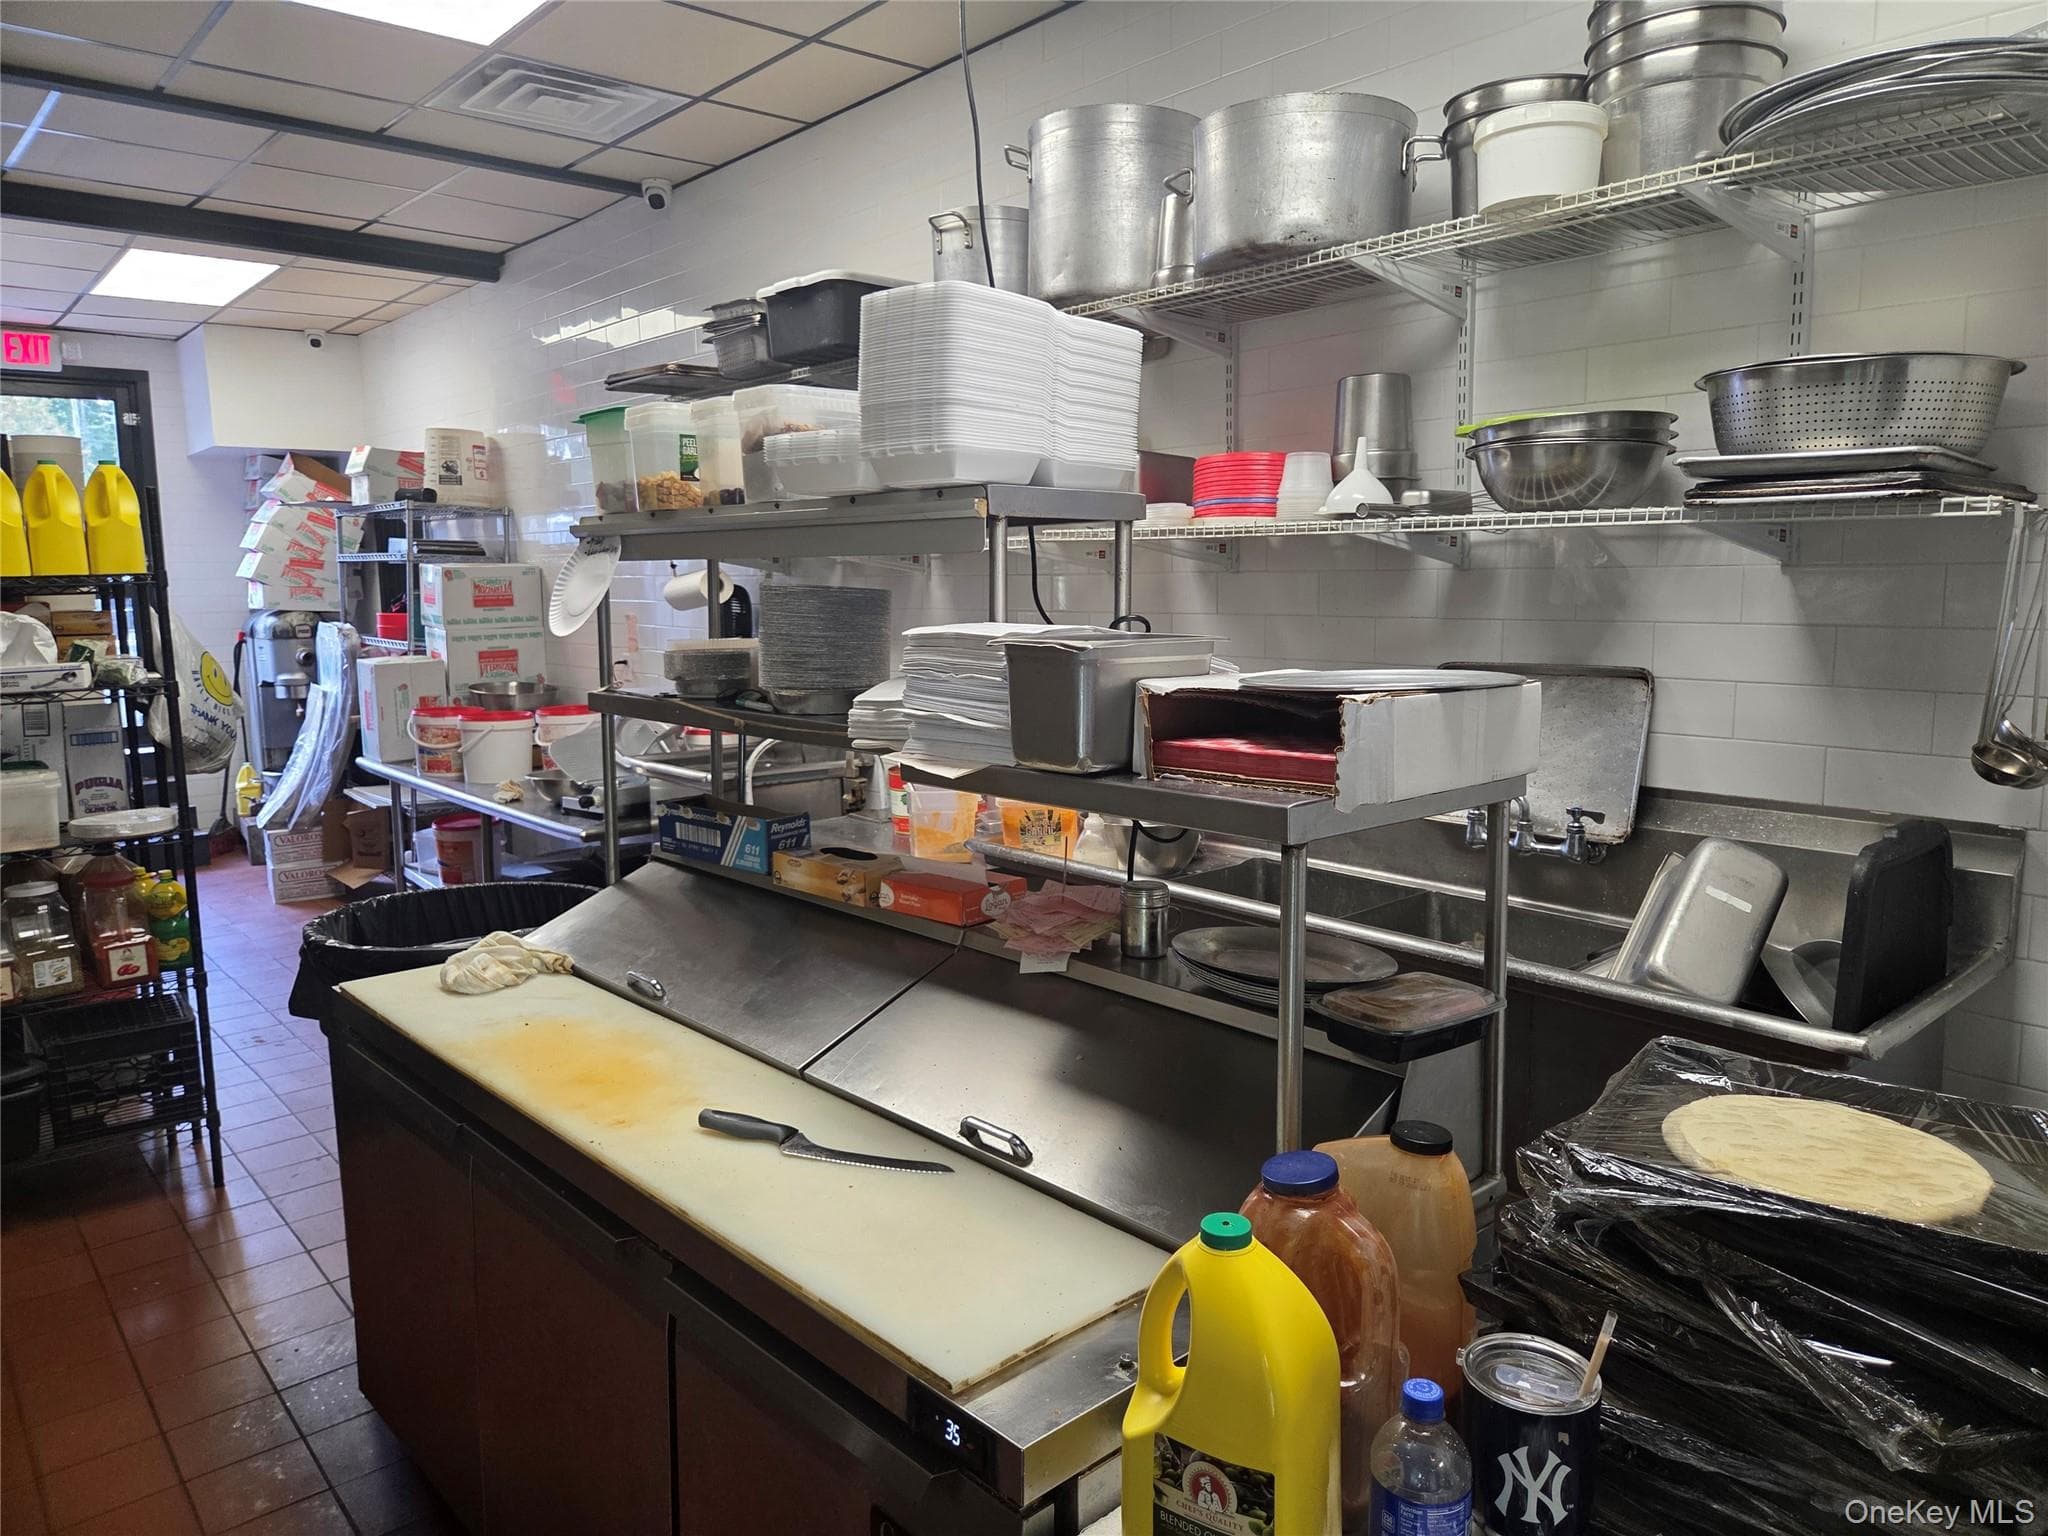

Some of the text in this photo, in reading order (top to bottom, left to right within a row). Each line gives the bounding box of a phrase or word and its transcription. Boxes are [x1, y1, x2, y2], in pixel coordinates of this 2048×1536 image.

[4, 333, 50, 365] EXIT
[190, 703, 219, 726] THANK
[771, 817, 808, 834] Reynolds
[745, 843, 760, 856] 611
[778, 837, 797, 850] 611
[945, 1419, 960, 1446] 35
[1494, 1445, 1572, 1527] NY
[1160, 1510, 1202, 1536] BLENDED
[1205, 1511, 1244, 1532] QUALITY
